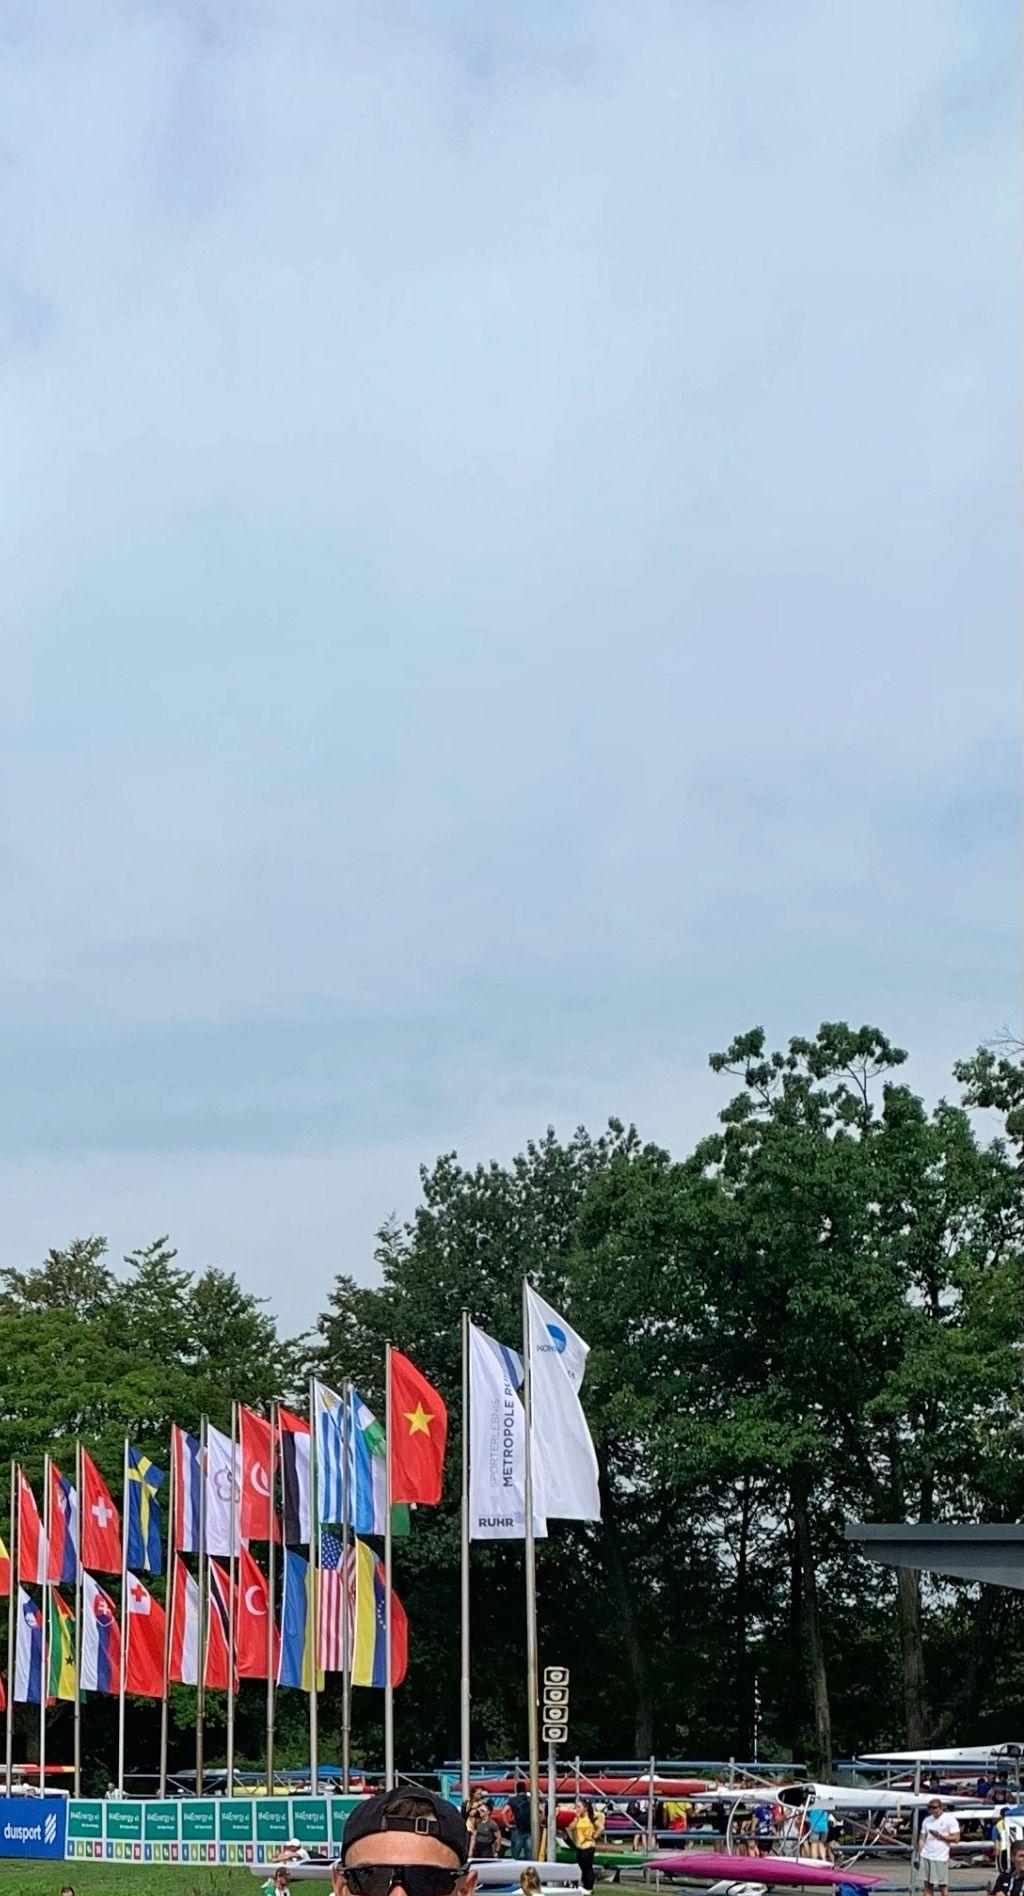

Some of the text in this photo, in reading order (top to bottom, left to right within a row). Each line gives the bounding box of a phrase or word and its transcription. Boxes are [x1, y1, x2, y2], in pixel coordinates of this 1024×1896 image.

[502, 1399, 515, 1487] METROPOLE
[478, 1517, 514, 1527] RUHR
[3, 1823, 42, 1844] duisport
